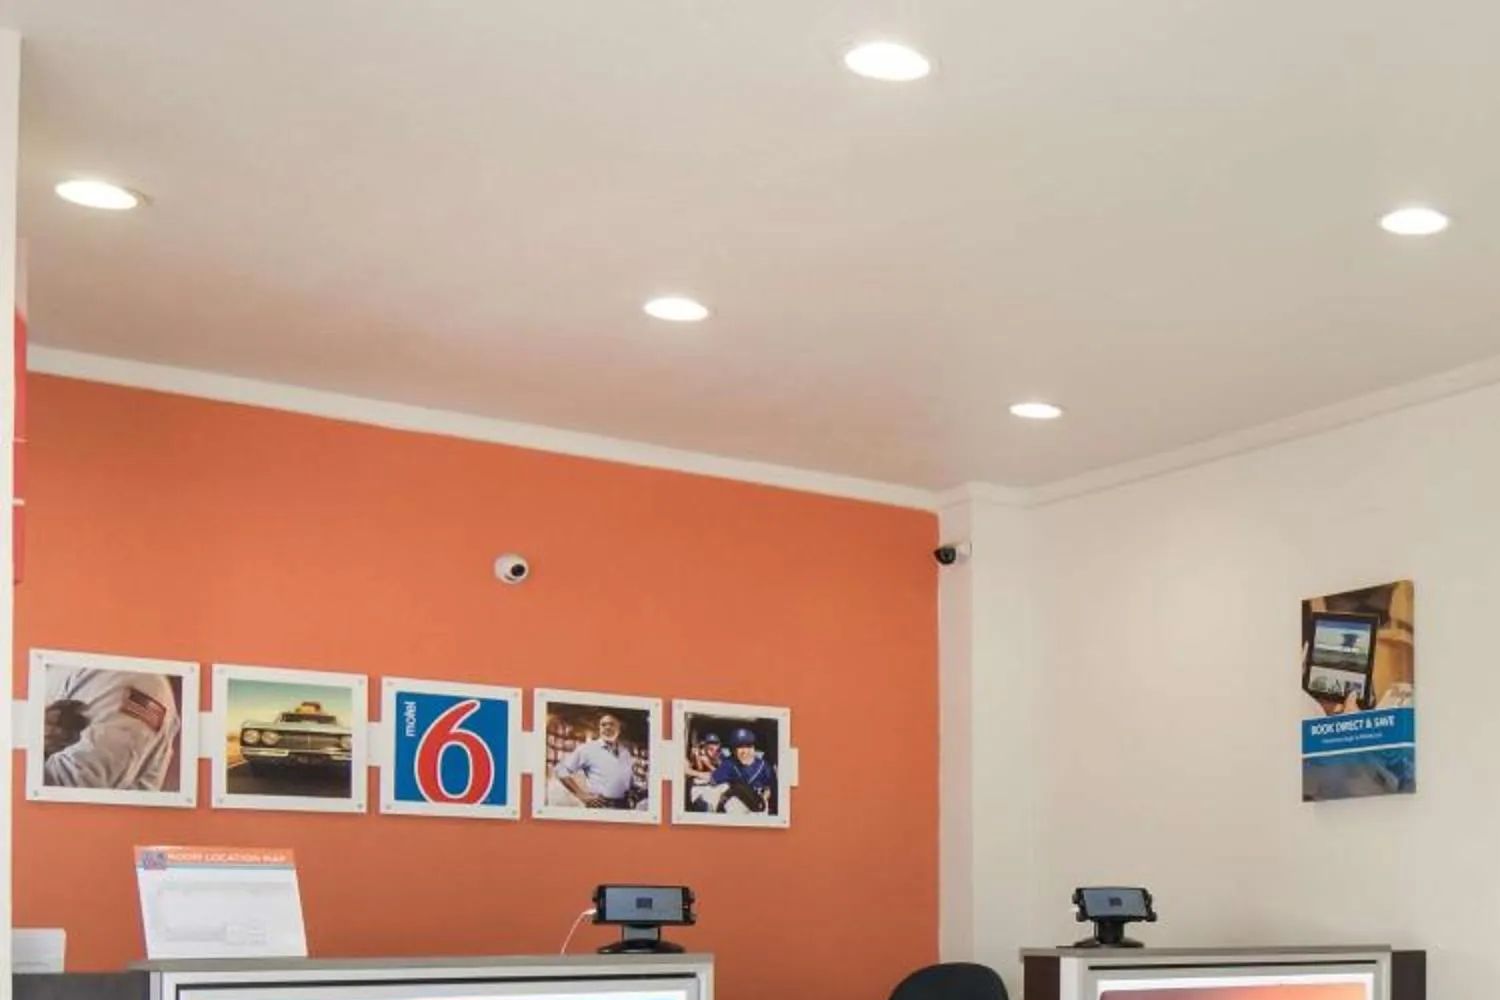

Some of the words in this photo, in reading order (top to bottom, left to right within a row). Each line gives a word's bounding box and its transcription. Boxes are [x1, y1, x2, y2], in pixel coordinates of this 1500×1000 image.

[1311, 723, 1334, 736] BOOK
[1336, 719, 1363, 733] DIRECT
[1374, 715, 1395, 727] SAVE
[404, 701, 416, 737] motel
[414, 700, 494, 805] 6
[205, 853, 260, 864] LOCATION
